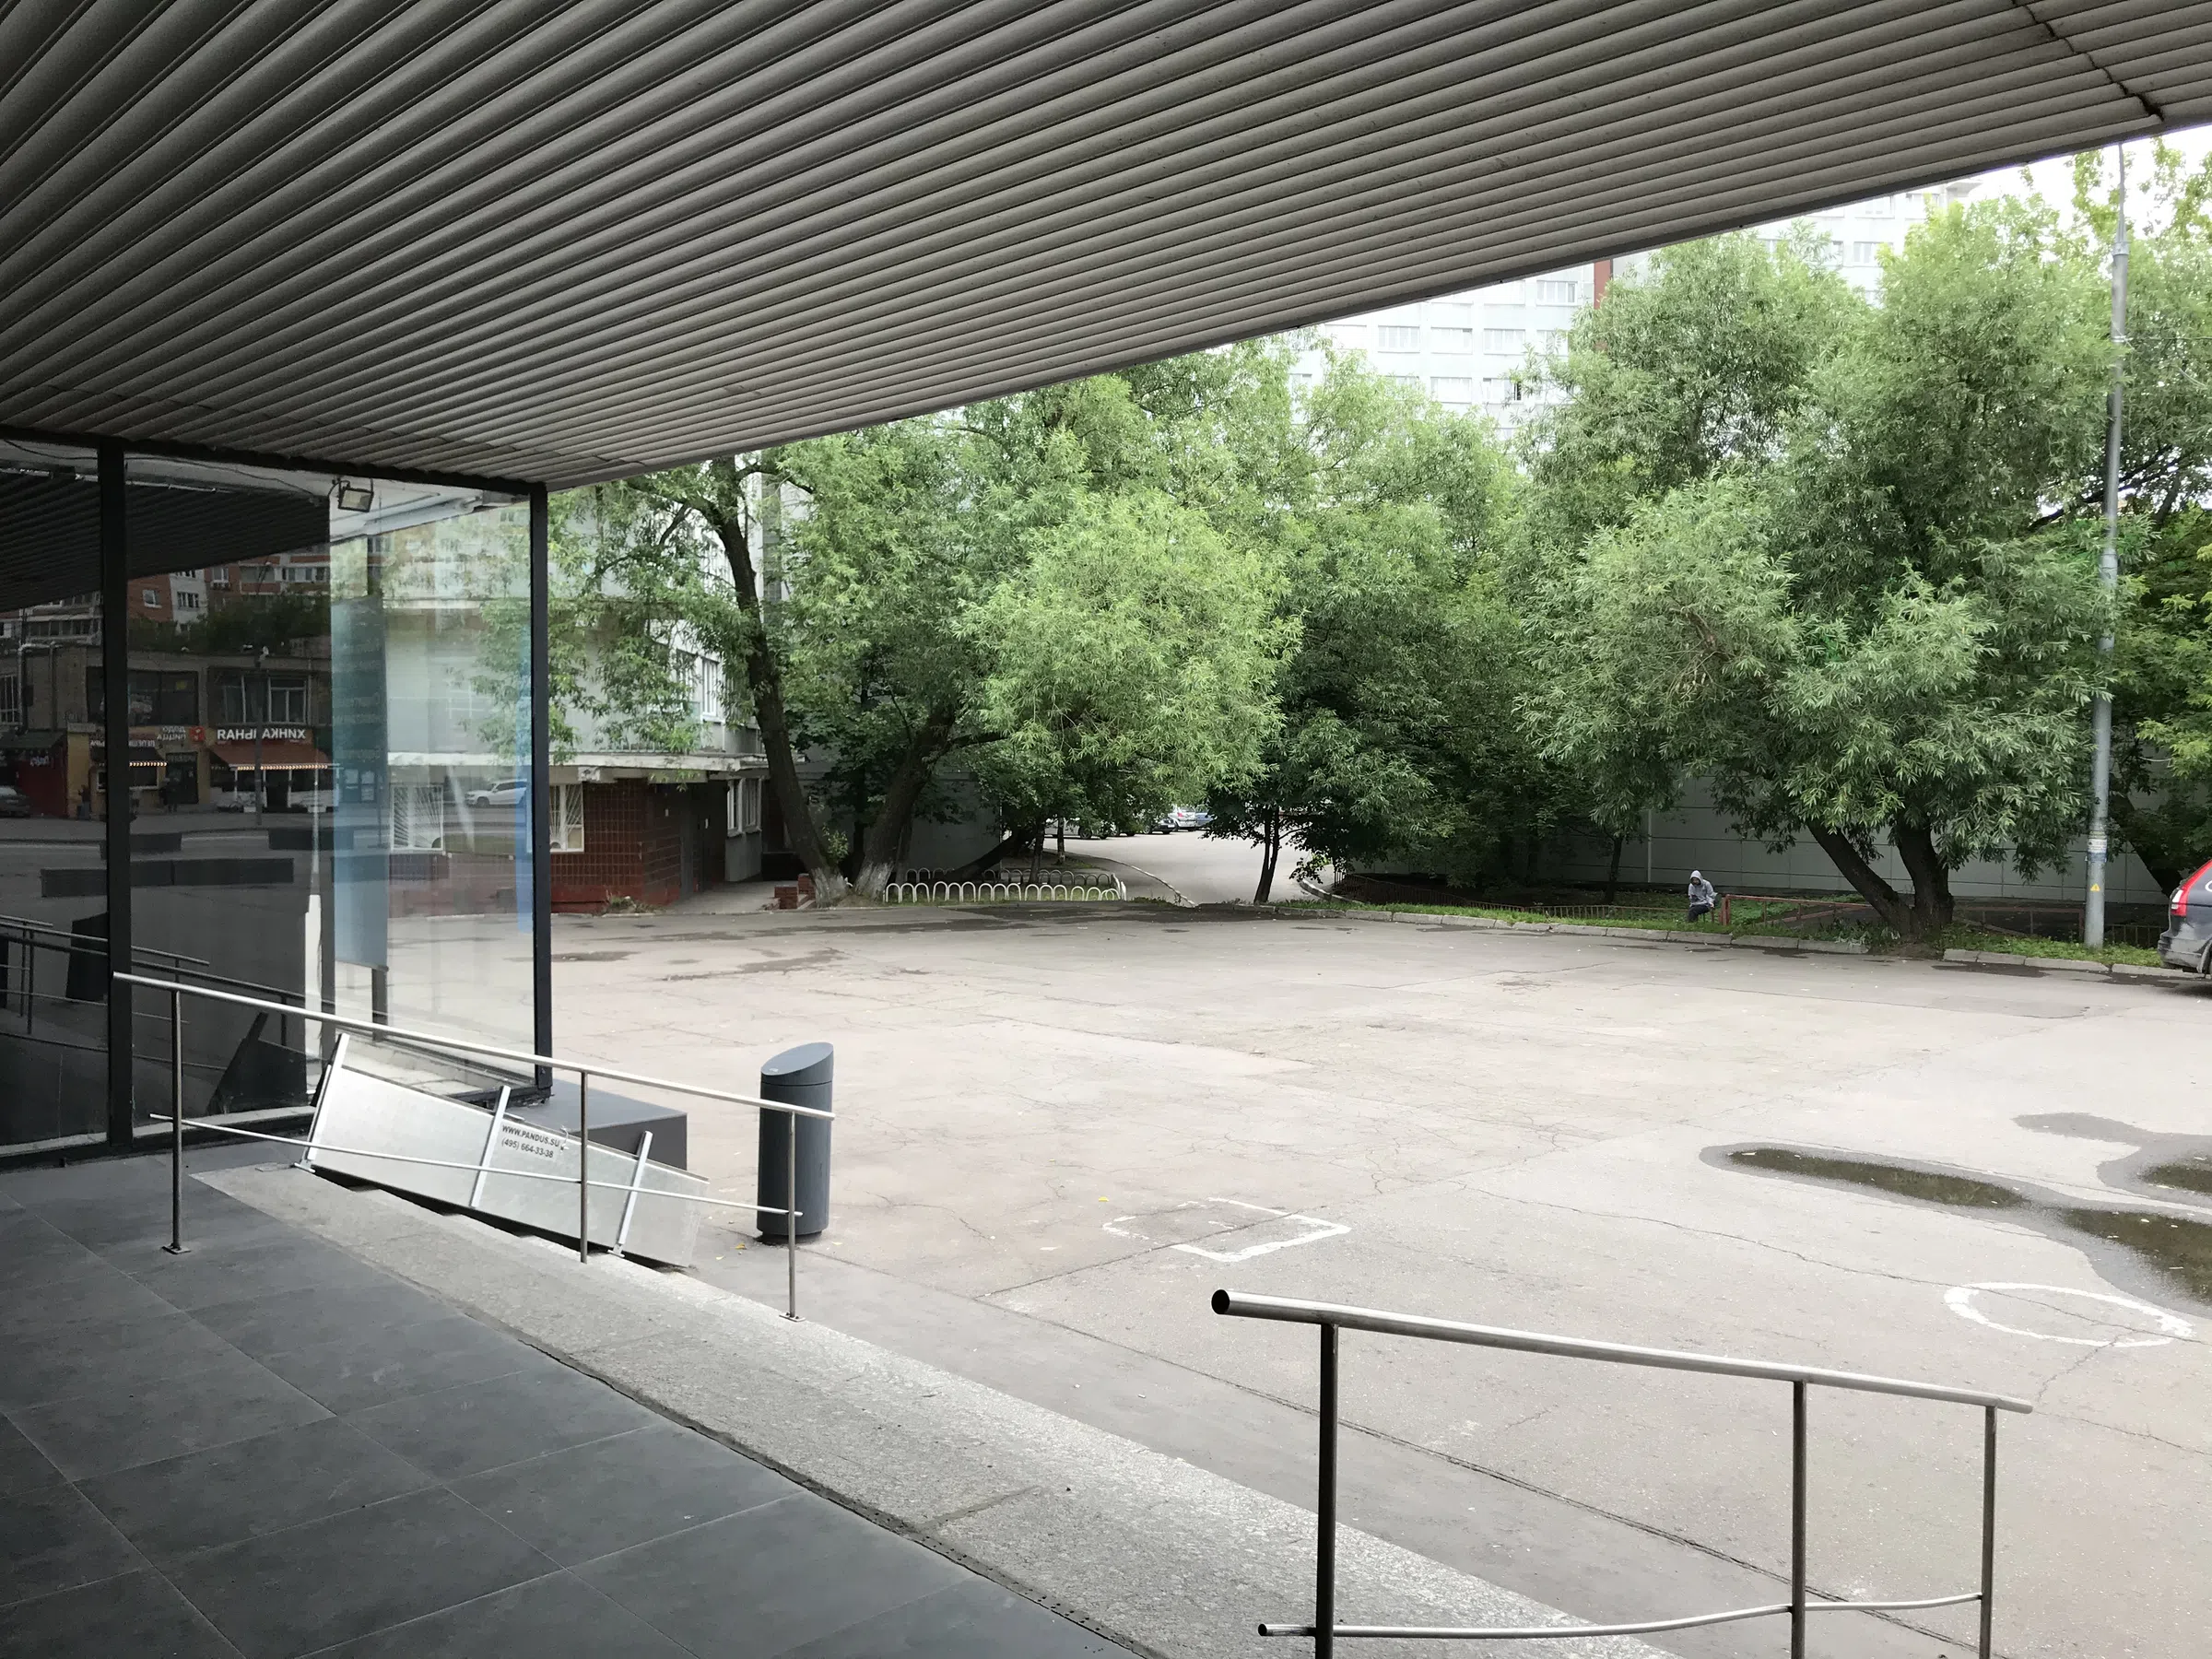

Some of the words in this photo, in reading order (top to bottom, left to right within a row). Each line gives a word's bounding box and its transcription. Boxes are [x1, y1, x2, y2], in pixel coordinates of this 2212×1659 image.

[501, 1124, 560, 1147] WWW.PANDUS.SU
[501, 1136, 520, 1150] (495)
[521, 1143, 554, 1159] 664-33-38
